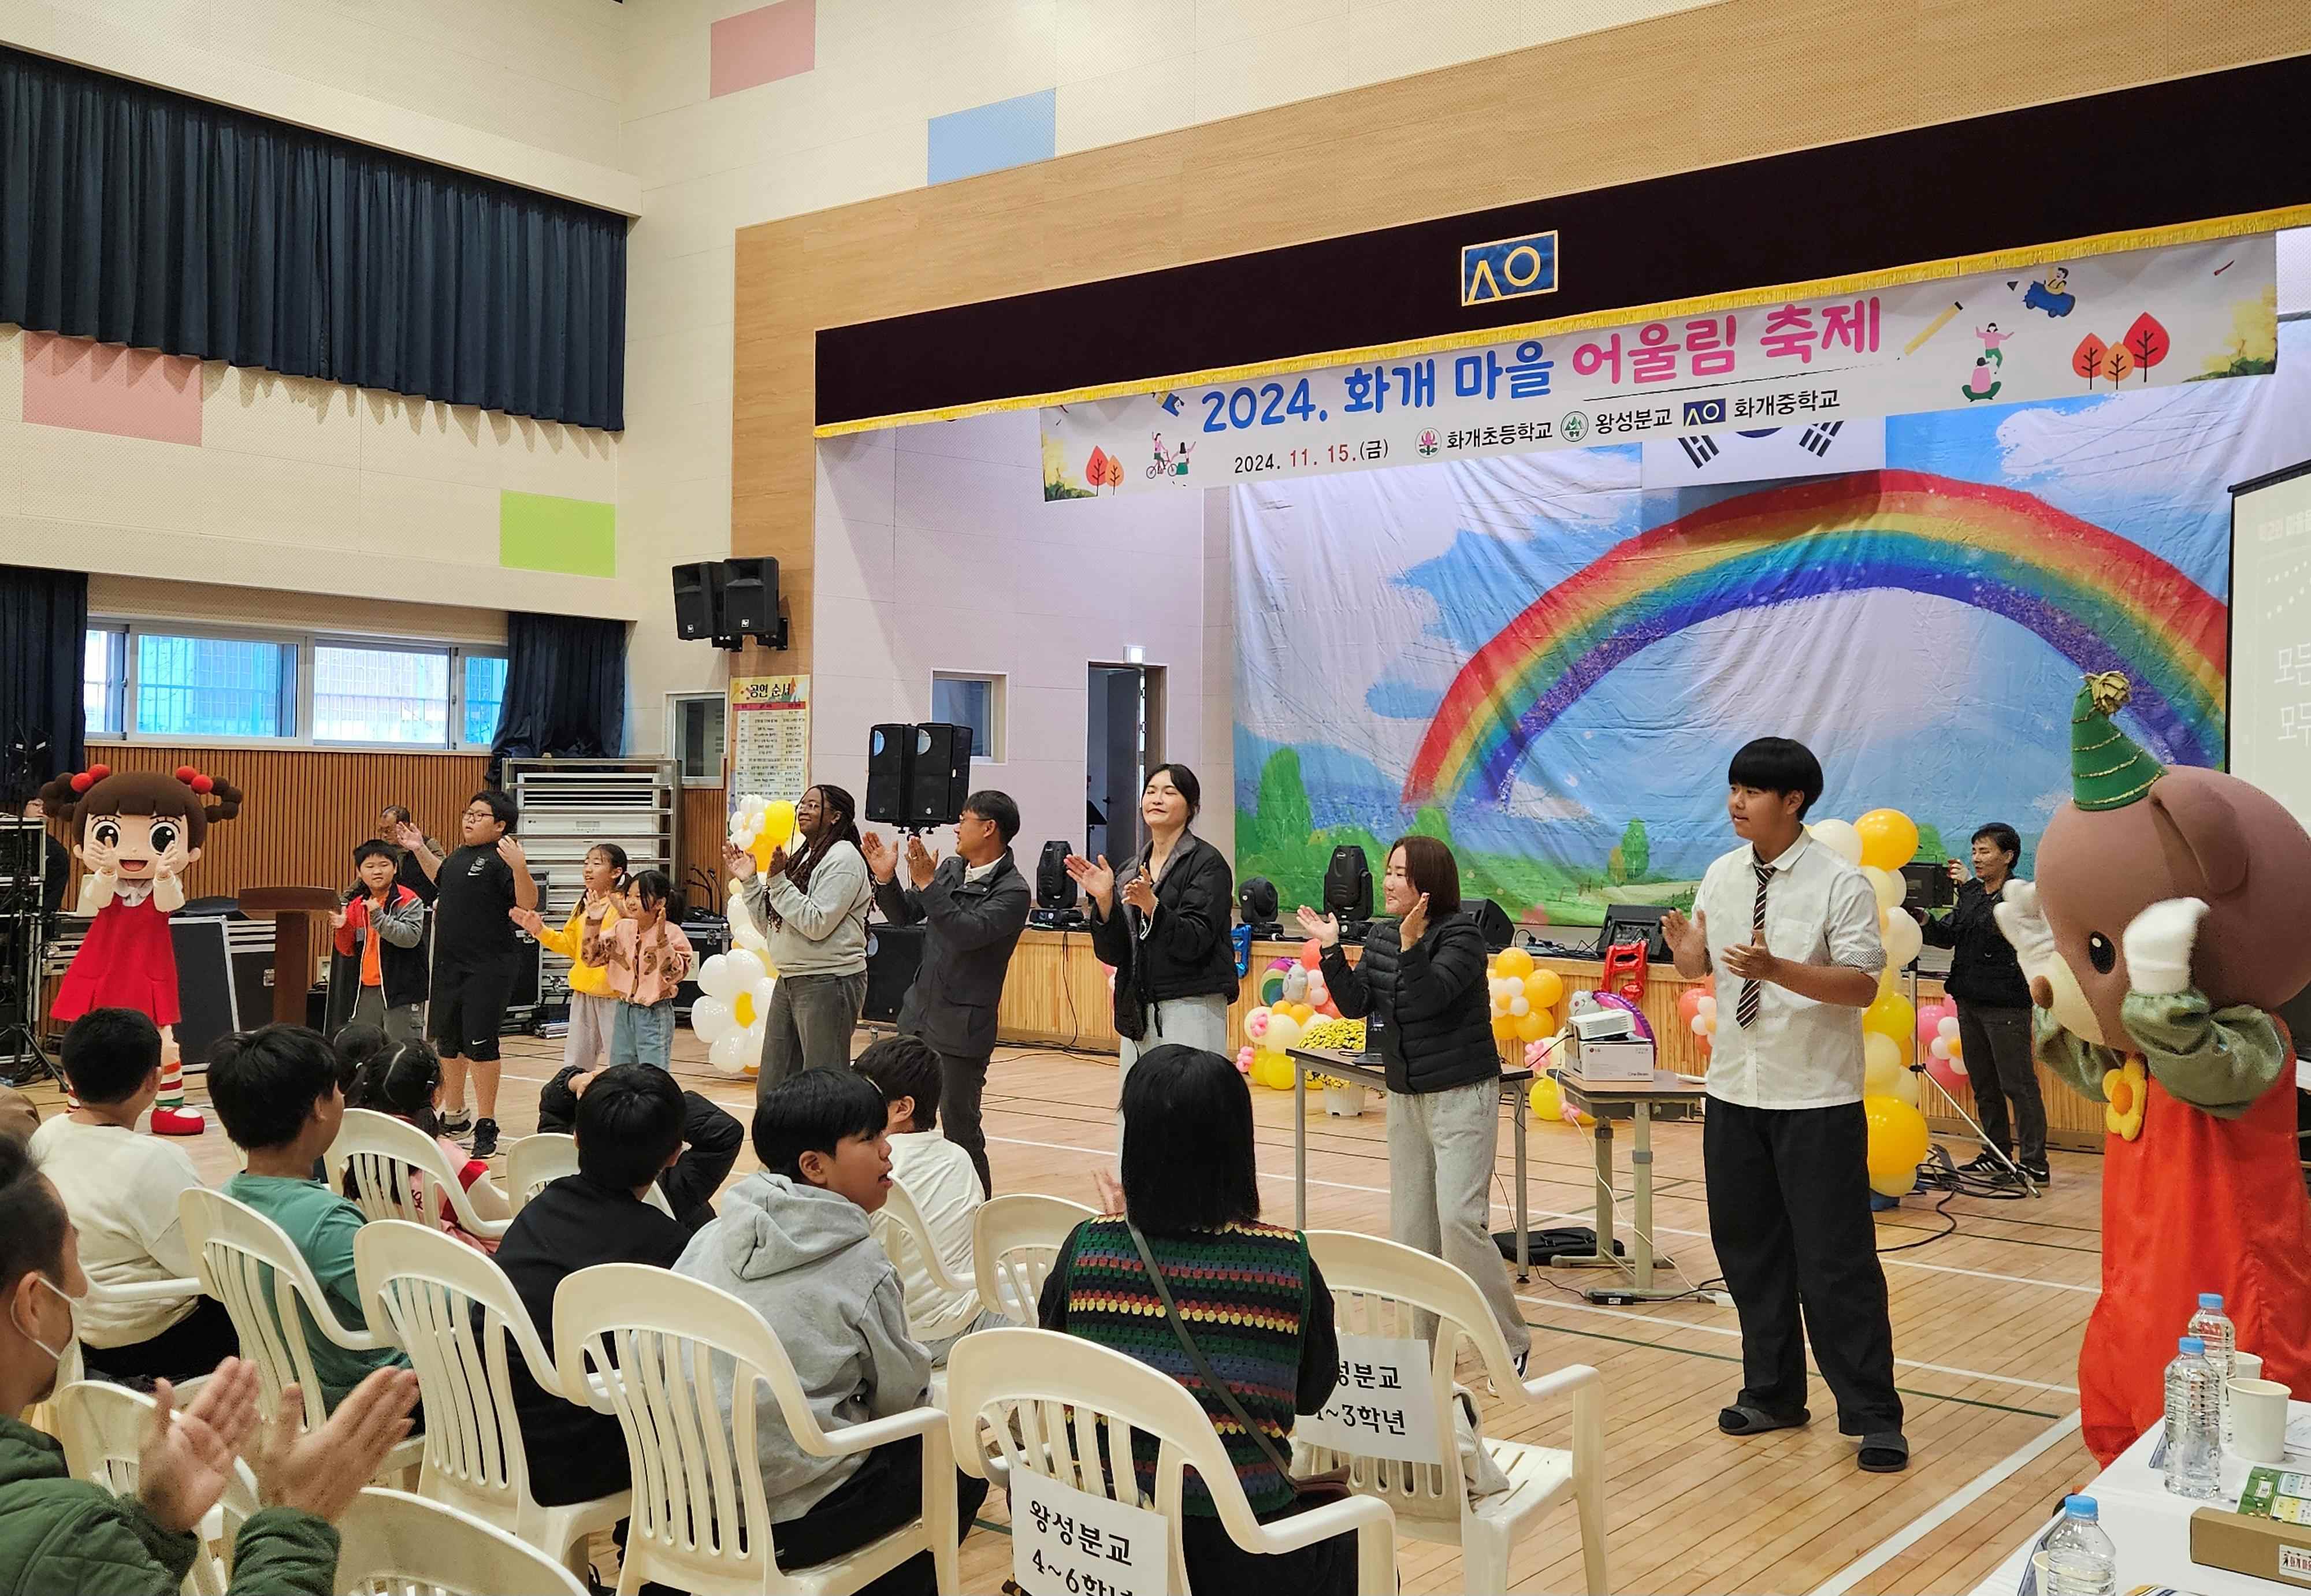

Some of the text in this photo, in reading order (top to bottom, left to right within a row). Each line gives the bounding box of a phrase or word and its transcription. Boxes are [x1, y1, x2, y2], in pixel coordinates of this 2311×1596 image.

[1202, 296, 1880, 433] 2024. 화개 마을 어울림 축제
[1235, 453, 1280, 474] 2024.
[1290, 449, 1317, 467] 11.
[1447, 421, 1553, 450] 화개초등학교
[1595, 408, 1673, 434] 왕성분교
[1734, 389, 1841, 419] 화개중학교
[750, 683, 791, 698] 공연 순서
[1030, 1500, 1132, 1567] 왕성분교
